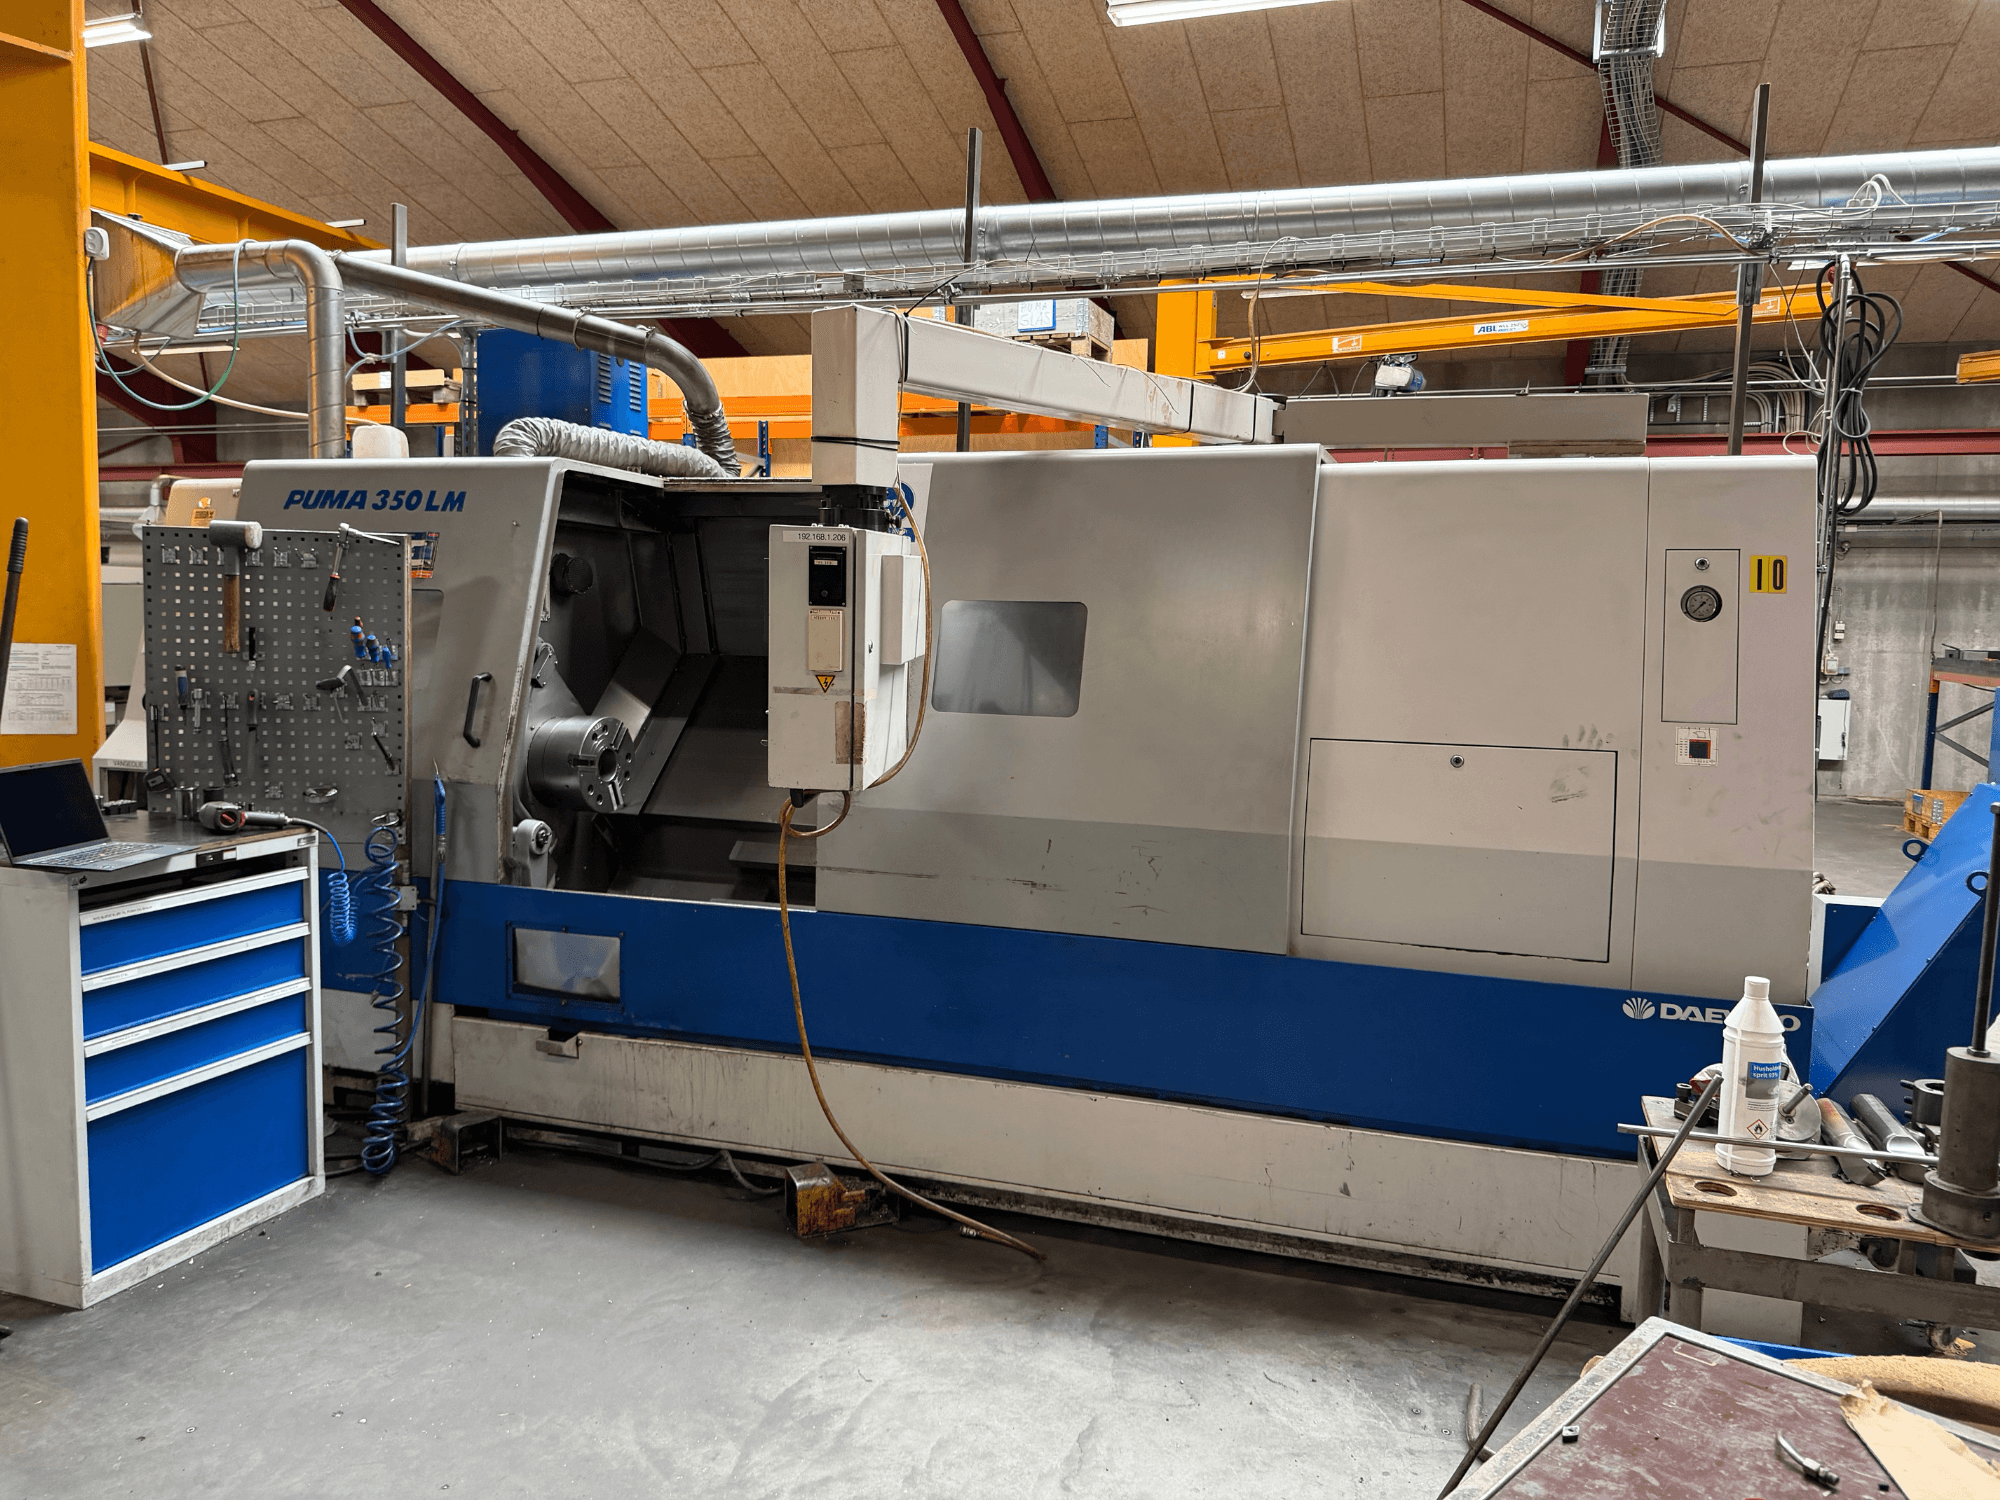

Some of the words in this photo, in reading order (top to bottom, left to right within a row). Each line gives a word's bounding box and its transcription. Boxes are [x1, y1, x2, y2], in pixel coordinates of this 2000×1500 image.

[1478, 325, 1497, 333] ABL
[283, 489, 368, 510] PUMA
[371, 489, 423, 511] 350
[424, 490, 467, 512] LM
[798, 533, 846, 541] 192.168.1.206
[1757, 558, 1784, 591] 10
